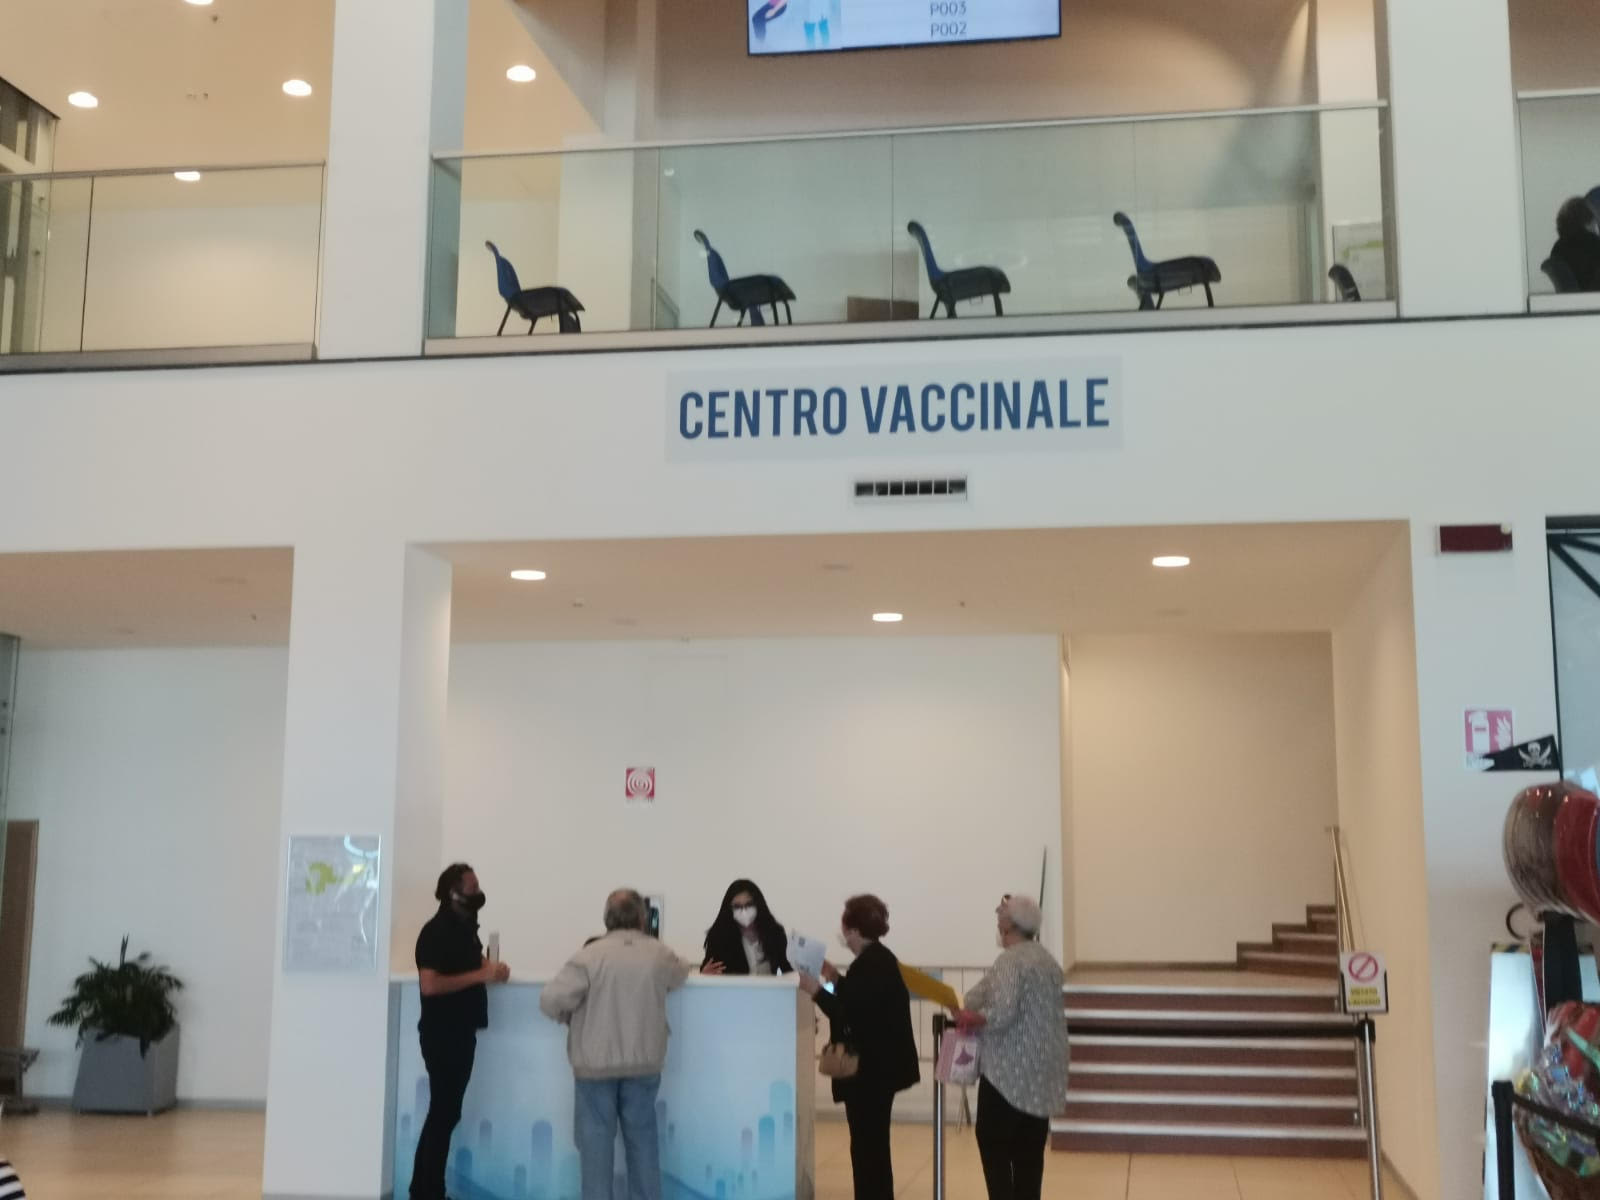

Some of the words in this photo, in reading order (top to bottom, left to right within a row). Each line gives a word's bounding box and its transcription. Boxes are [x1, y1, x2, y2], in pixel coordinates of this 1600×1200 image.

[930, 1, 967, 16] P003
[930, 22, 967, 38] P002
[679, 386, 848, 440] CENTRO
[860, 377, 1110, 434] VACCINALE
